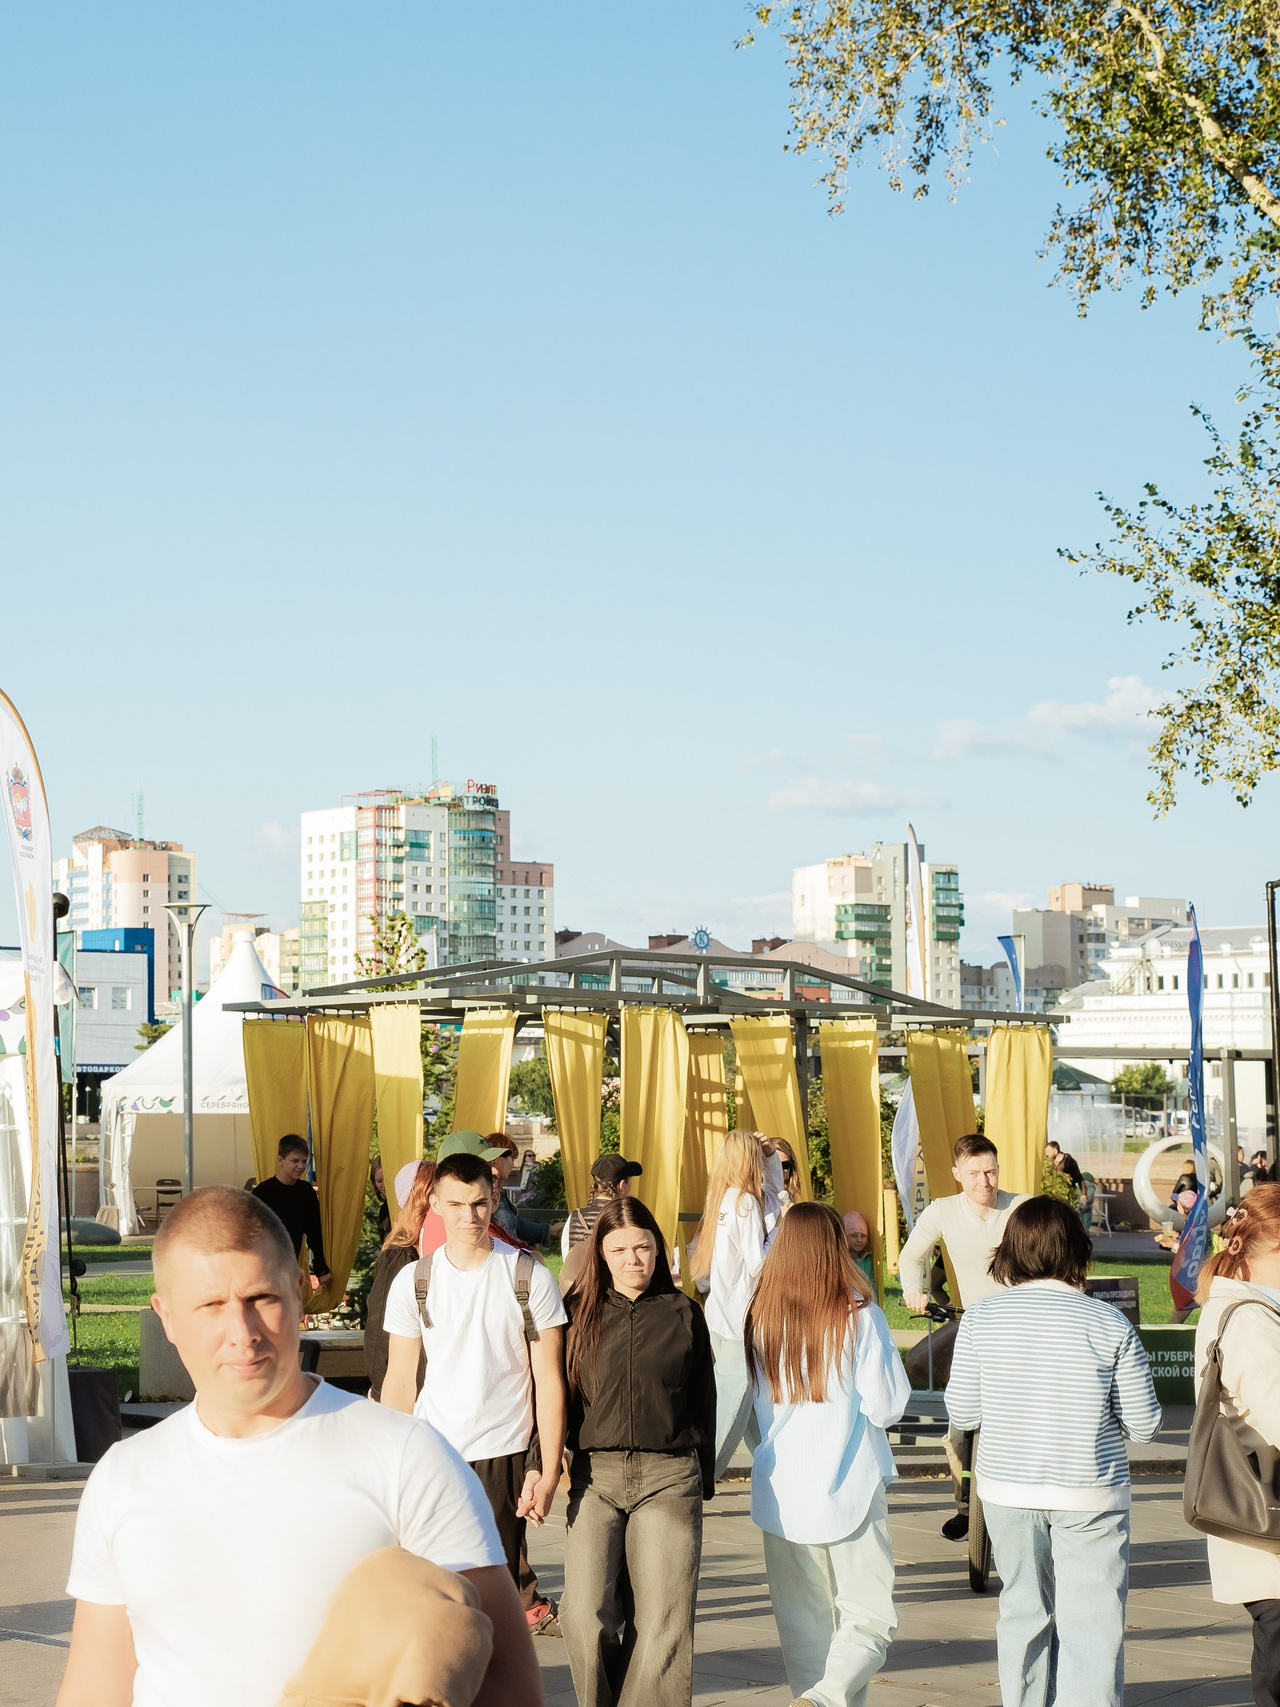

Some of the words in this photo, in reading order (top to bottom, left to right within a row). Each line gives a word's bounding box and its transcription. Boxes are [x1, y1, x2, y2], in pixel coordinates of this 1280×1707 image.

[200, 1101, 248, 1109] СЕРЕБРЯНО
[1158, 1351, 1195, 1361] ГУБЕРН
[1150, 1364, 1180, 1377] СКОЙ
